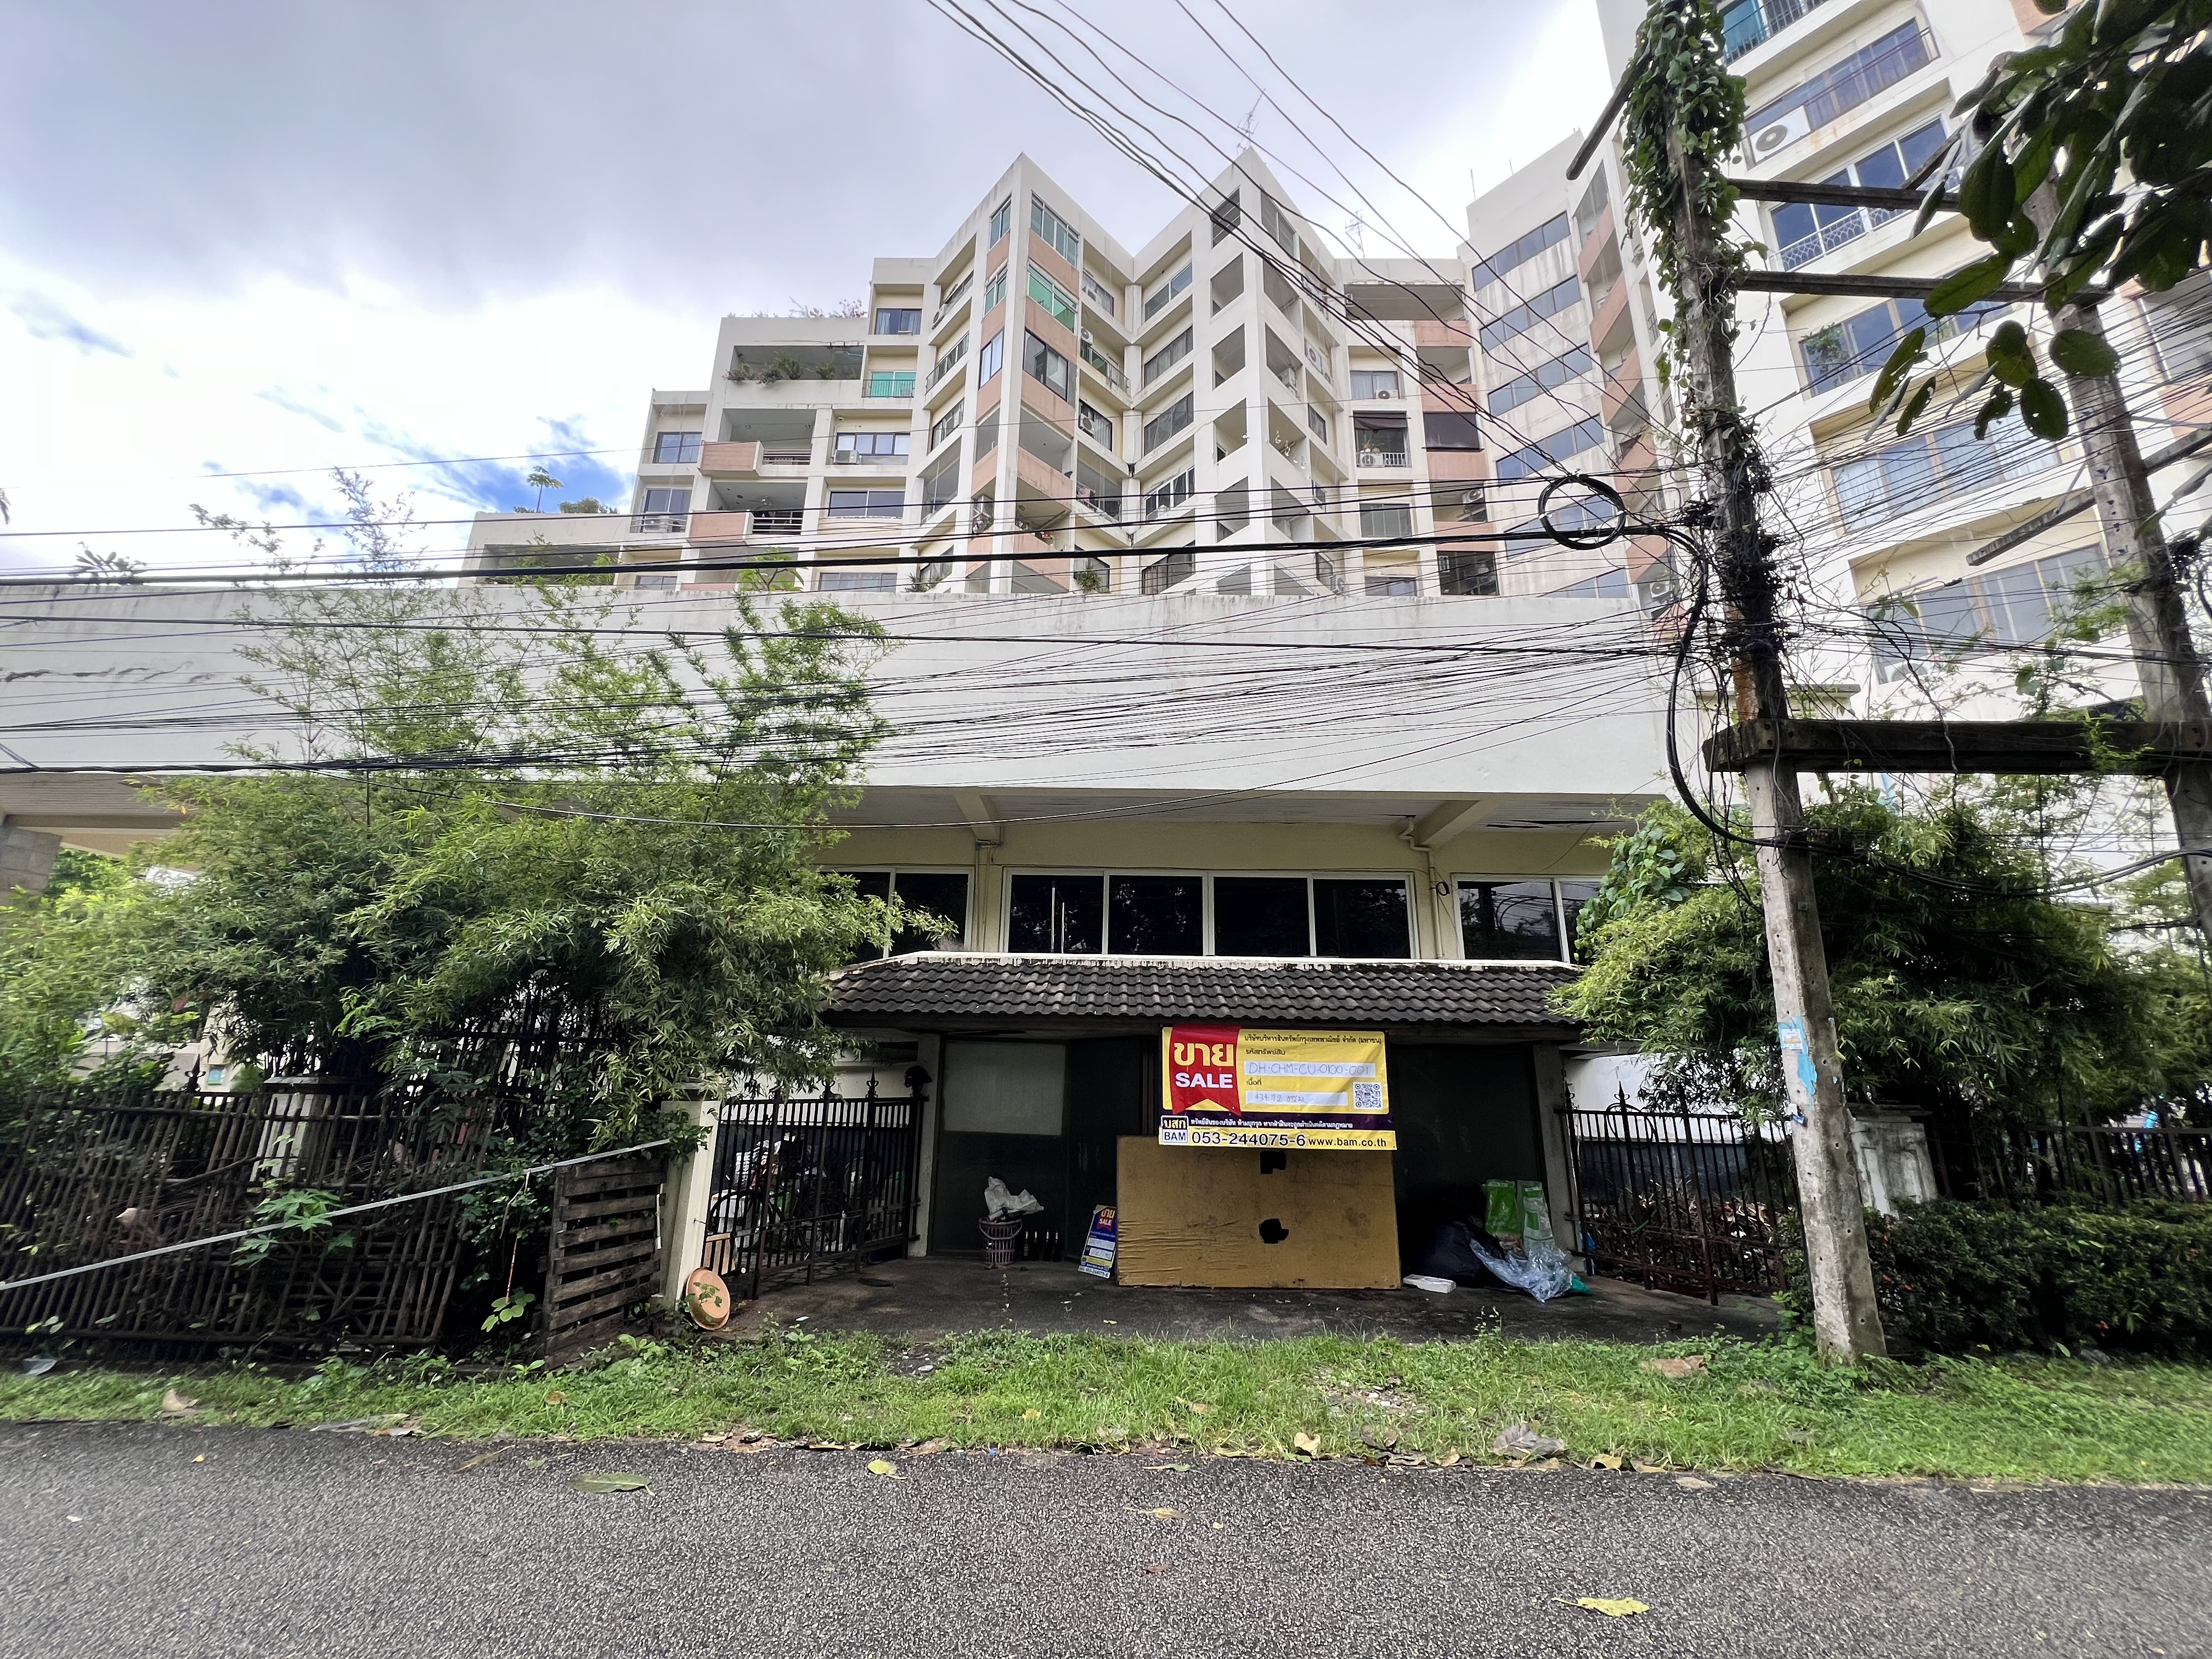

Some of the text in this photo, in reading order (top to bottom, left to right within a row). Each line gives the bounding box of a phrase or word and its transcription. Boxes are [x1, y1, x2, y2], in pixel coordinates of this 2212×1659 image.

[1174, 1042, 1234, 1066] ขาย
[1175, 1072, 1233, 1088] SALE
[1163, 1118, 1186, 1129] บสก
[1164, 1131, 1186, 1141] BAM
[1192, 1132, 1387, 1147] 053-244075-6 www.bam.co.th
[1099, 1218, 1112, 1226] SALE
